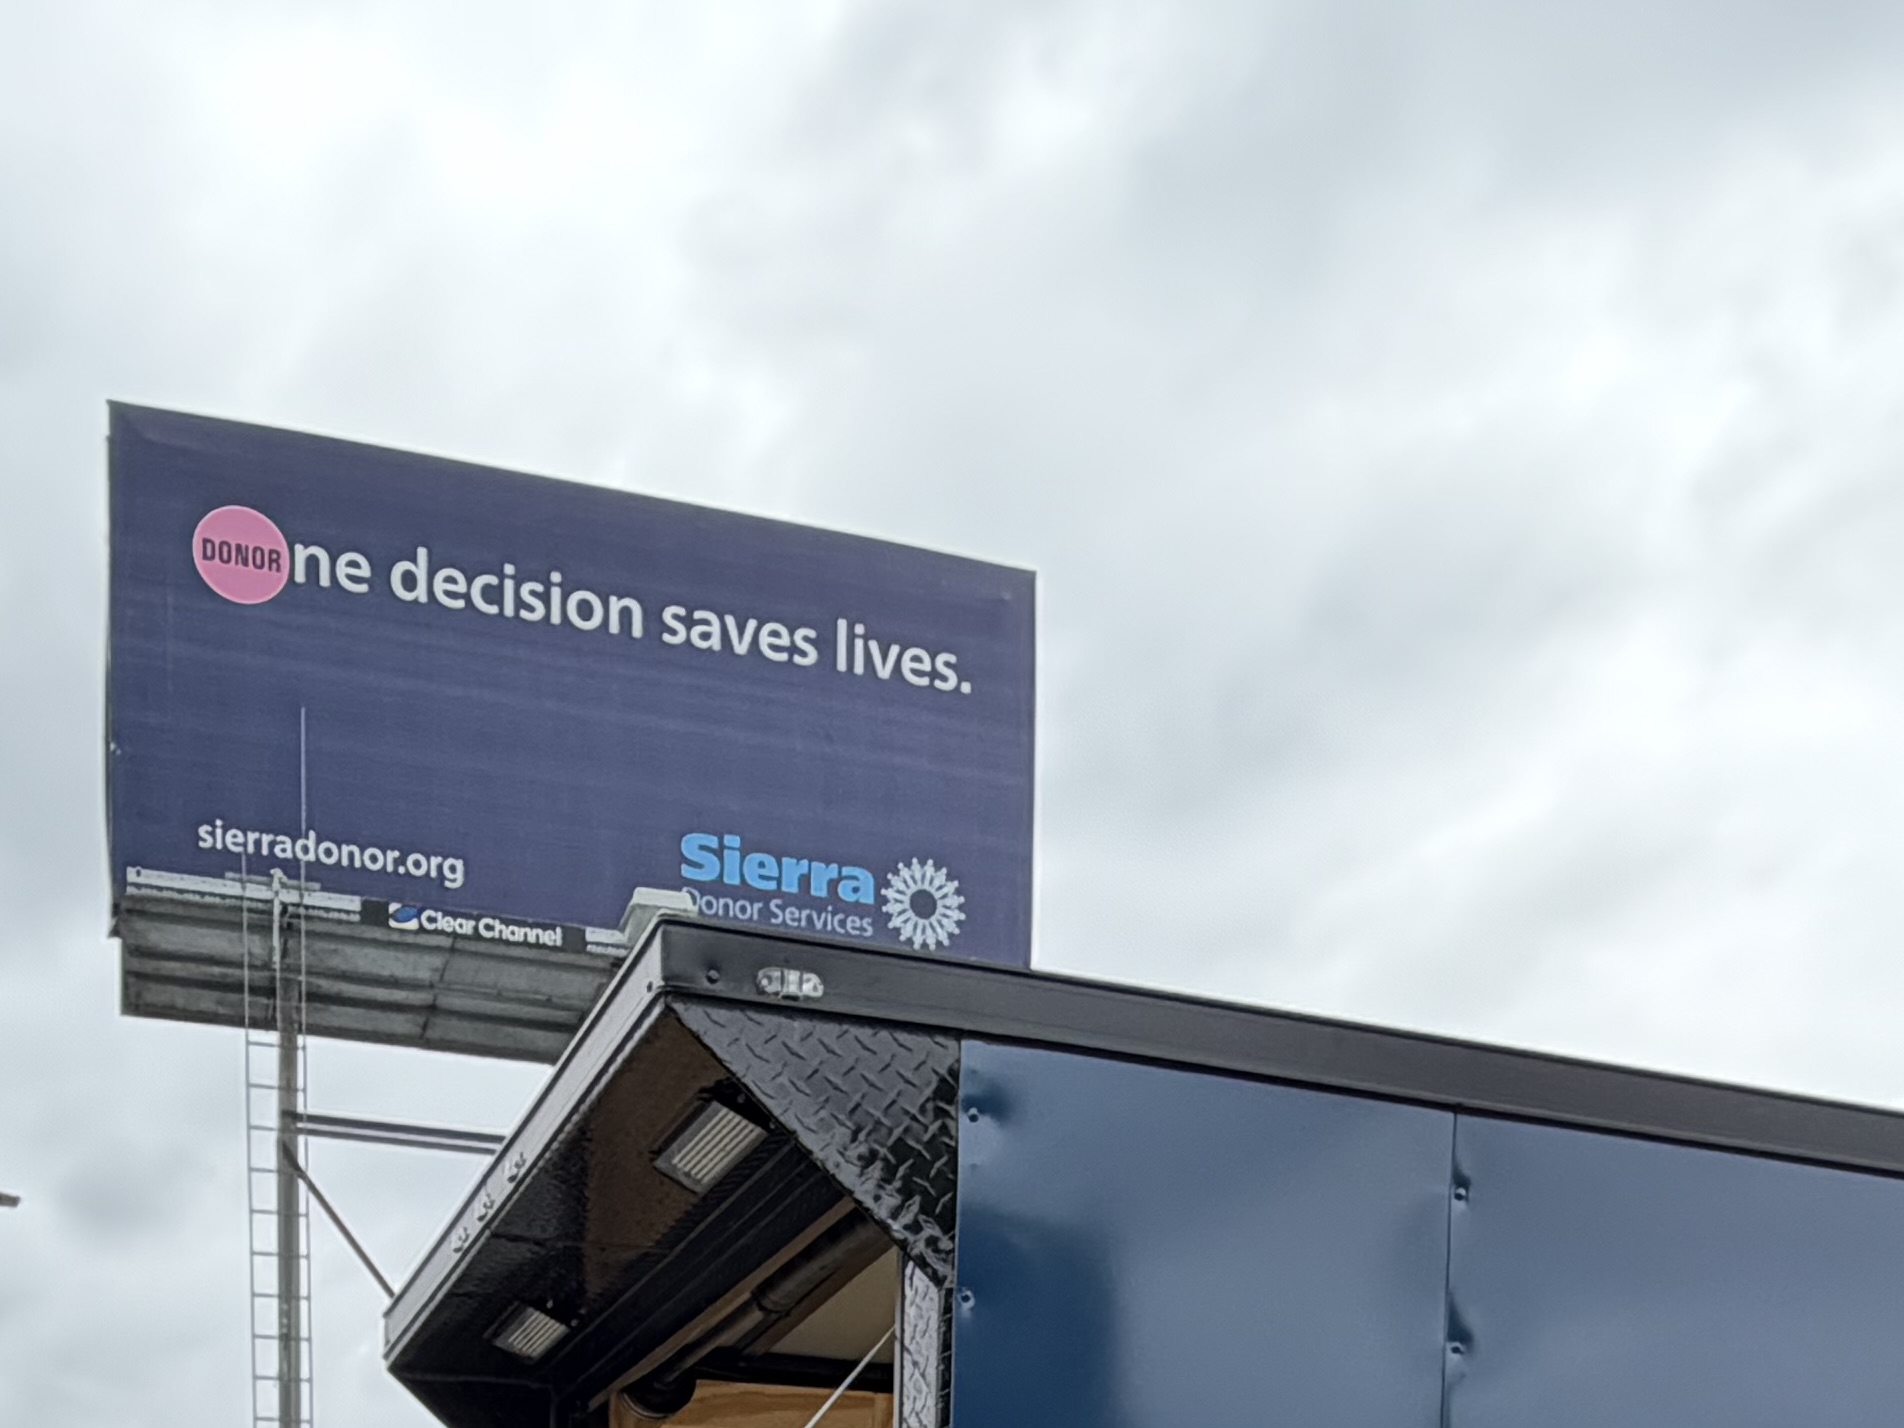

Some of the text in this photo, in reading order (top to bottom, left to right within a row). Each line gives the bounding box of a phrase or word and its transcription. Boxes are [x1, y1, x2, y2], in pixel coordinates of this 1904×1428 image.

[200, 537, 282, 573] DONOR
[294, 542, 972, 694] ne decision saves lives.
[197, 818, 466, 889] sierradonor.org
[680, 832, 875, 904] Sierra
[420, 908, 563, 948] Clear Channel
[769, 899, 874, 937] Services
